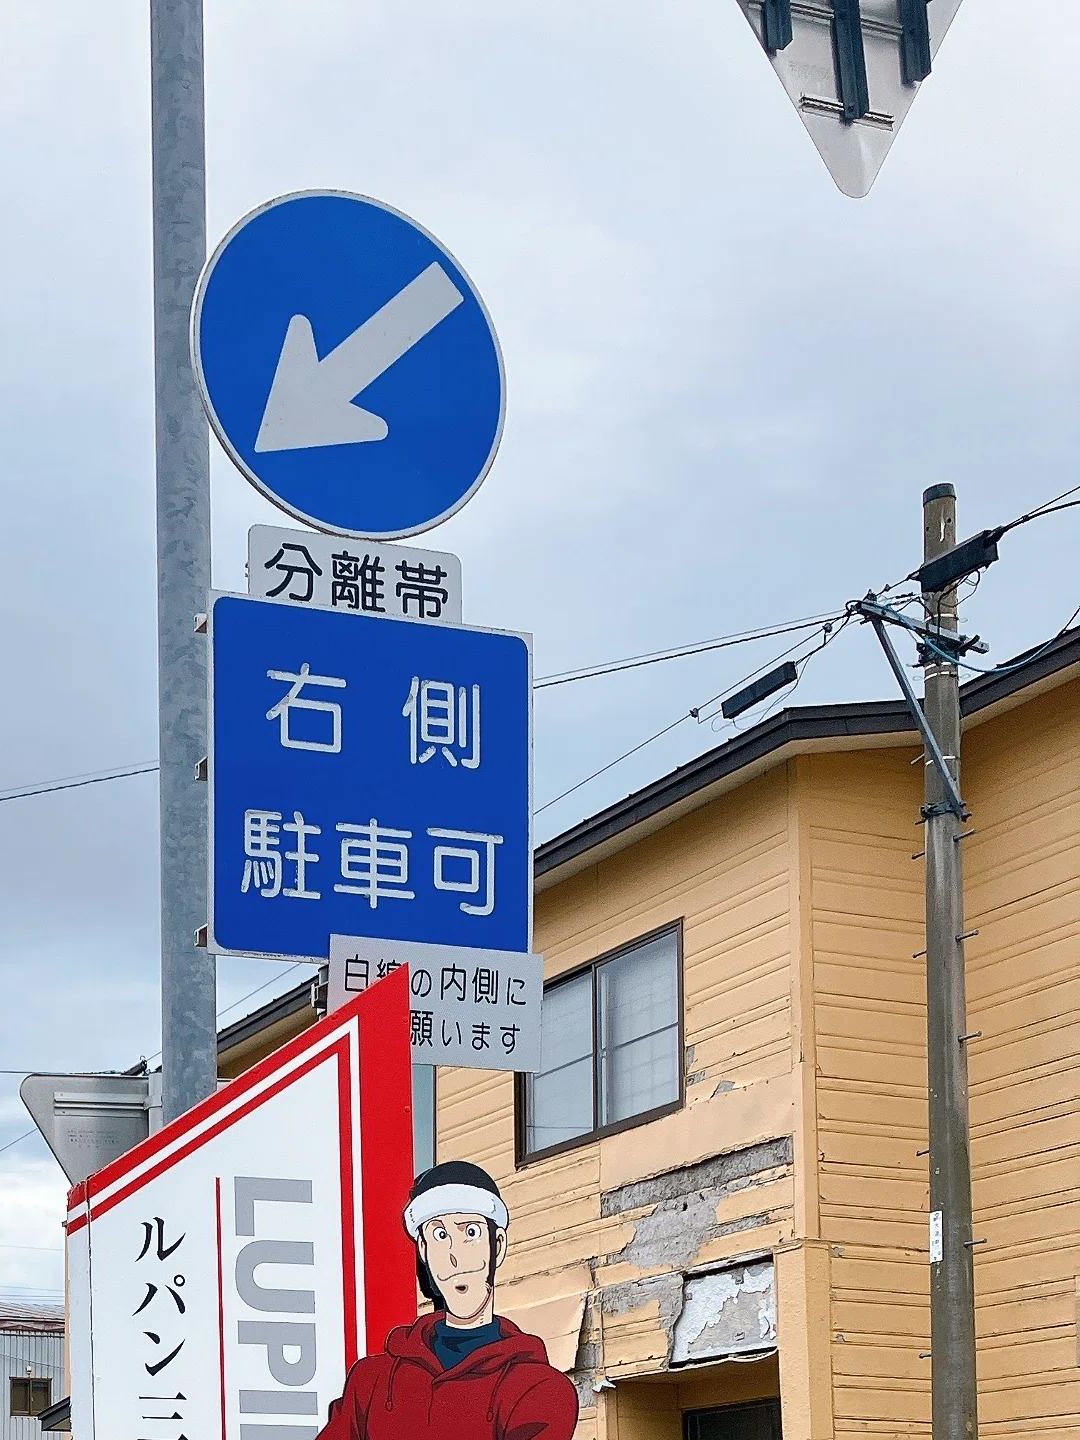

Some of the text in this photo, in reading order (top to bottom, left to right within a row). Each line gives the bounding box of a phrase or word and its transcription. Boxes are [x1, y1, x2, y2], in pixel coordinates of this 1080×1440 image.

[264, 543, 449, 618] 分離帯
[266, 663, 481, 769] 右側
[241, 808, 504, 916] 駐車可
